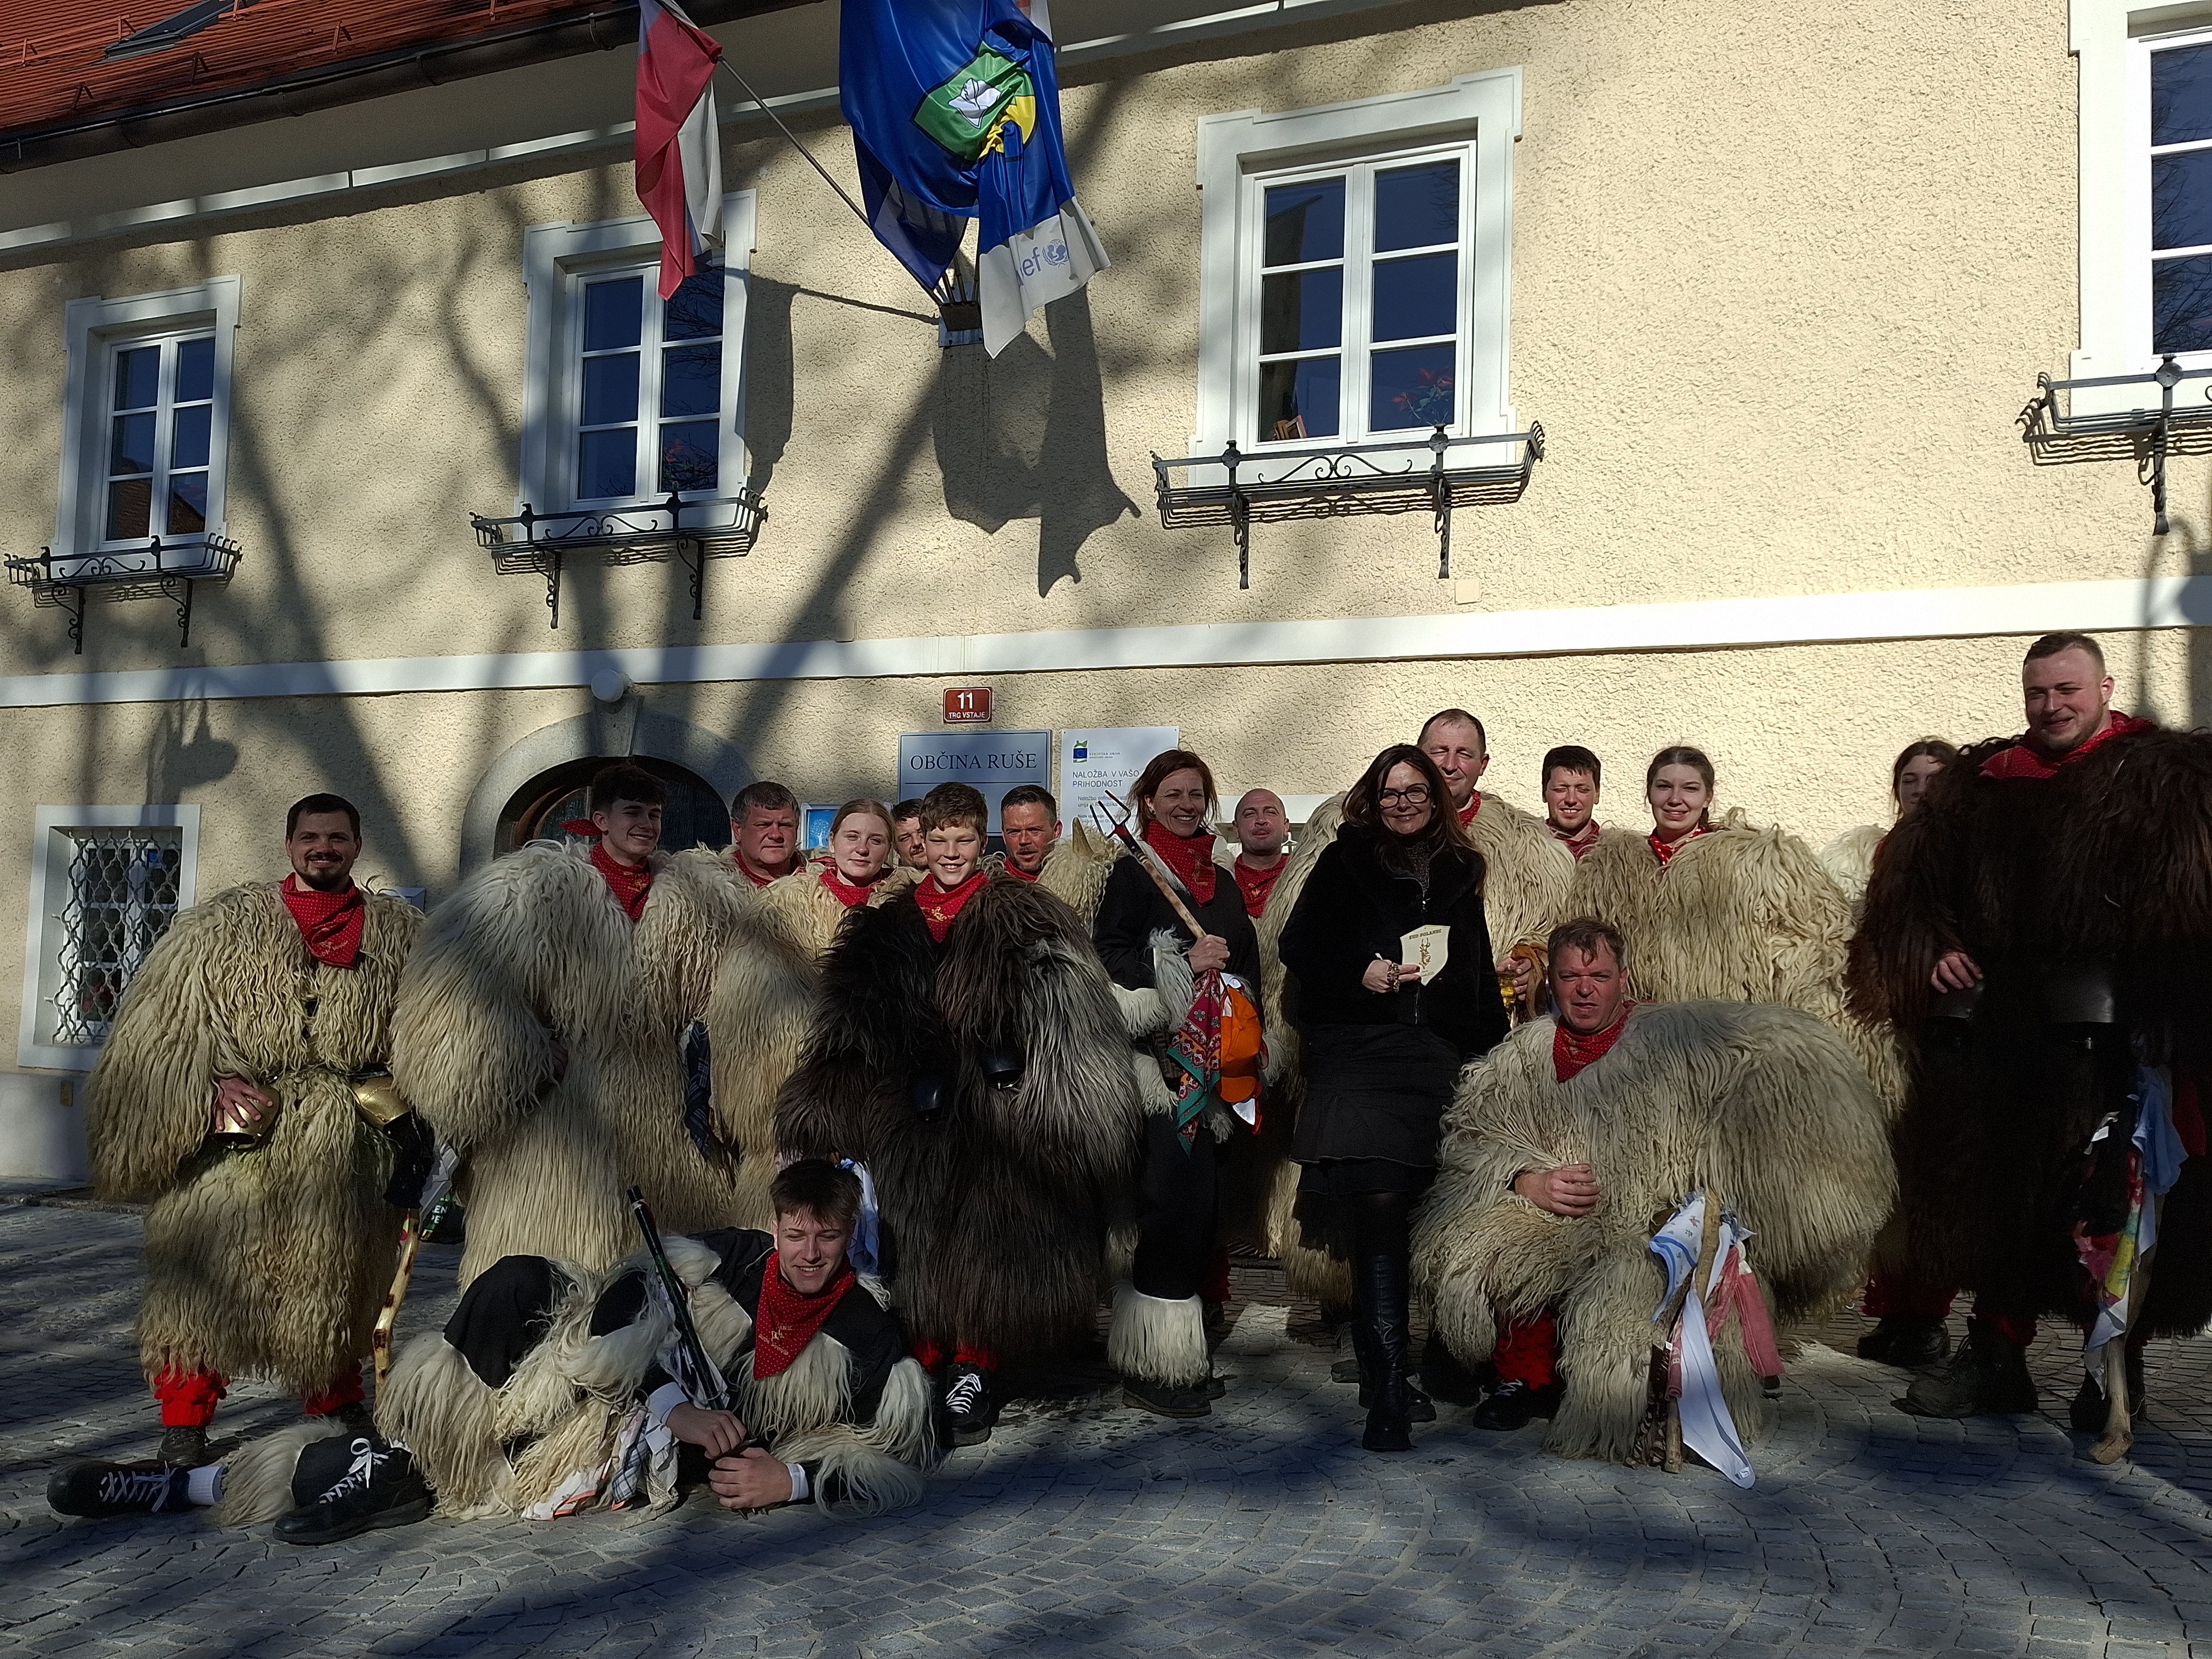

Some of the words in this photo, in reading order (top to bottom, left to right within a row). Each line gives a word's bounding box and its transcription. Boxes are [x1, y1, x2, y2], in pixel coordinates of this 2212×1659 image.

[957, 692, 973, 709] 11
[910, 751, 982, 770] OBČINA
[987, 749, 1037, 769] RUŠE
[1072, 769, 1108, 778] NALOŽBA
[1118, 769, 1140, 777] VAŠO
